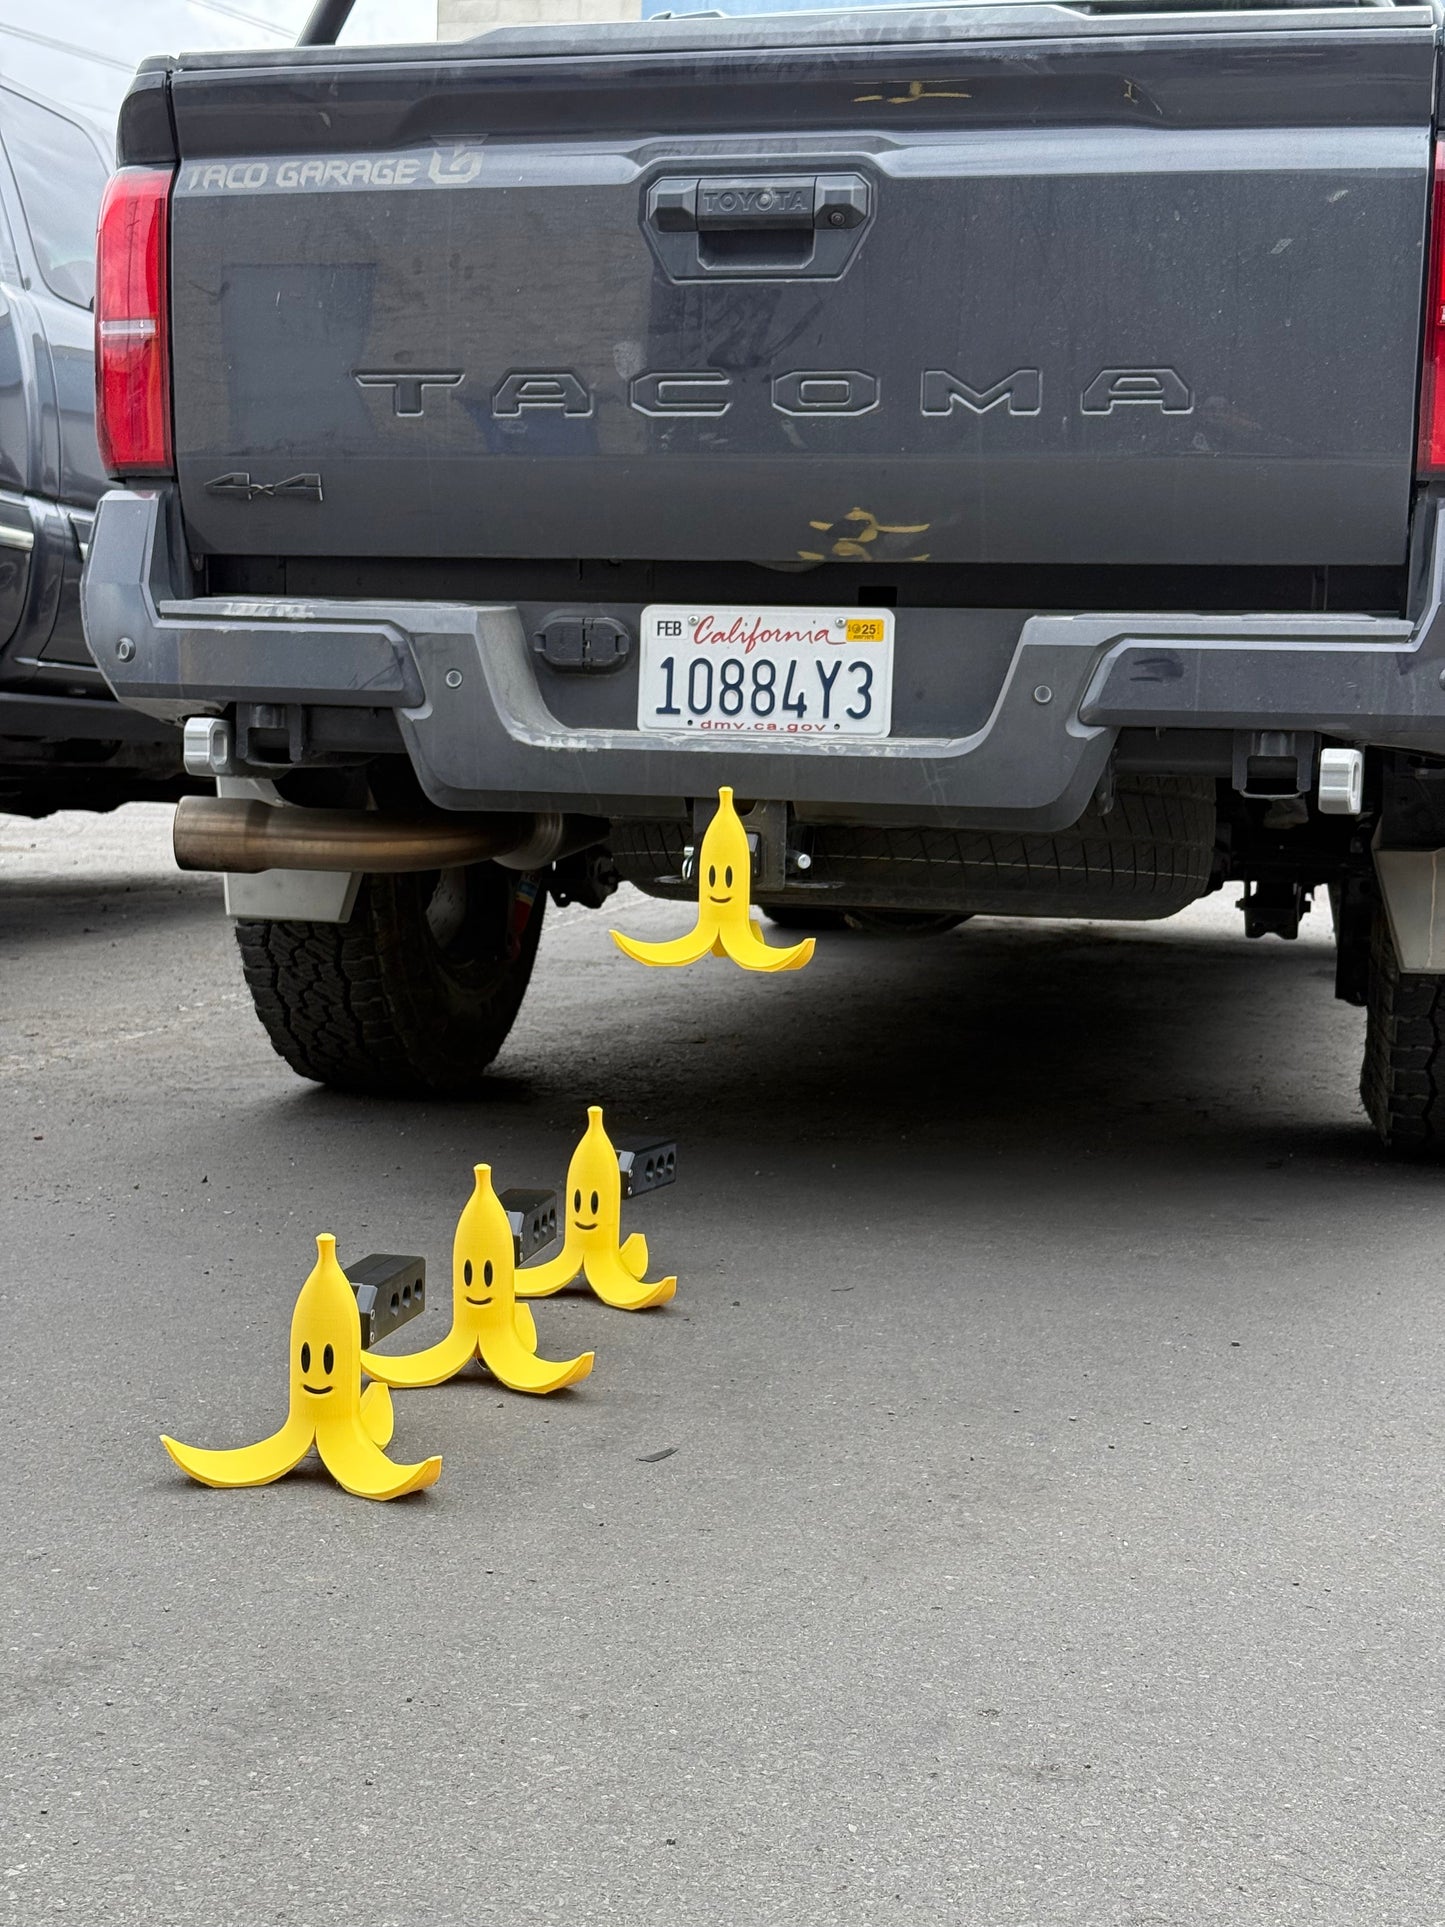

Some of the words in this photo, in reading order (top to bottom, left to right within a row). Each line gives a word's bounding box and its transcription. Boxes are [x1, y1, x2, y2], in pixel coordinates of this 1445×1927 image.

[188, 164, 267, 190] TACO
[276, 159, 420, 188] GARAGE
[703, 190, 808, 211] TOYOTA
[355, 370, 1195, 419] TACOMA
[657, 621, 682, 637] FEB
[694, 616, 846, 653] California
[861, 624, 876, 635] 25
[657, 656, 874, 720] 10884Y3
[701, 720, 826, 733] dmv.ca.gov
